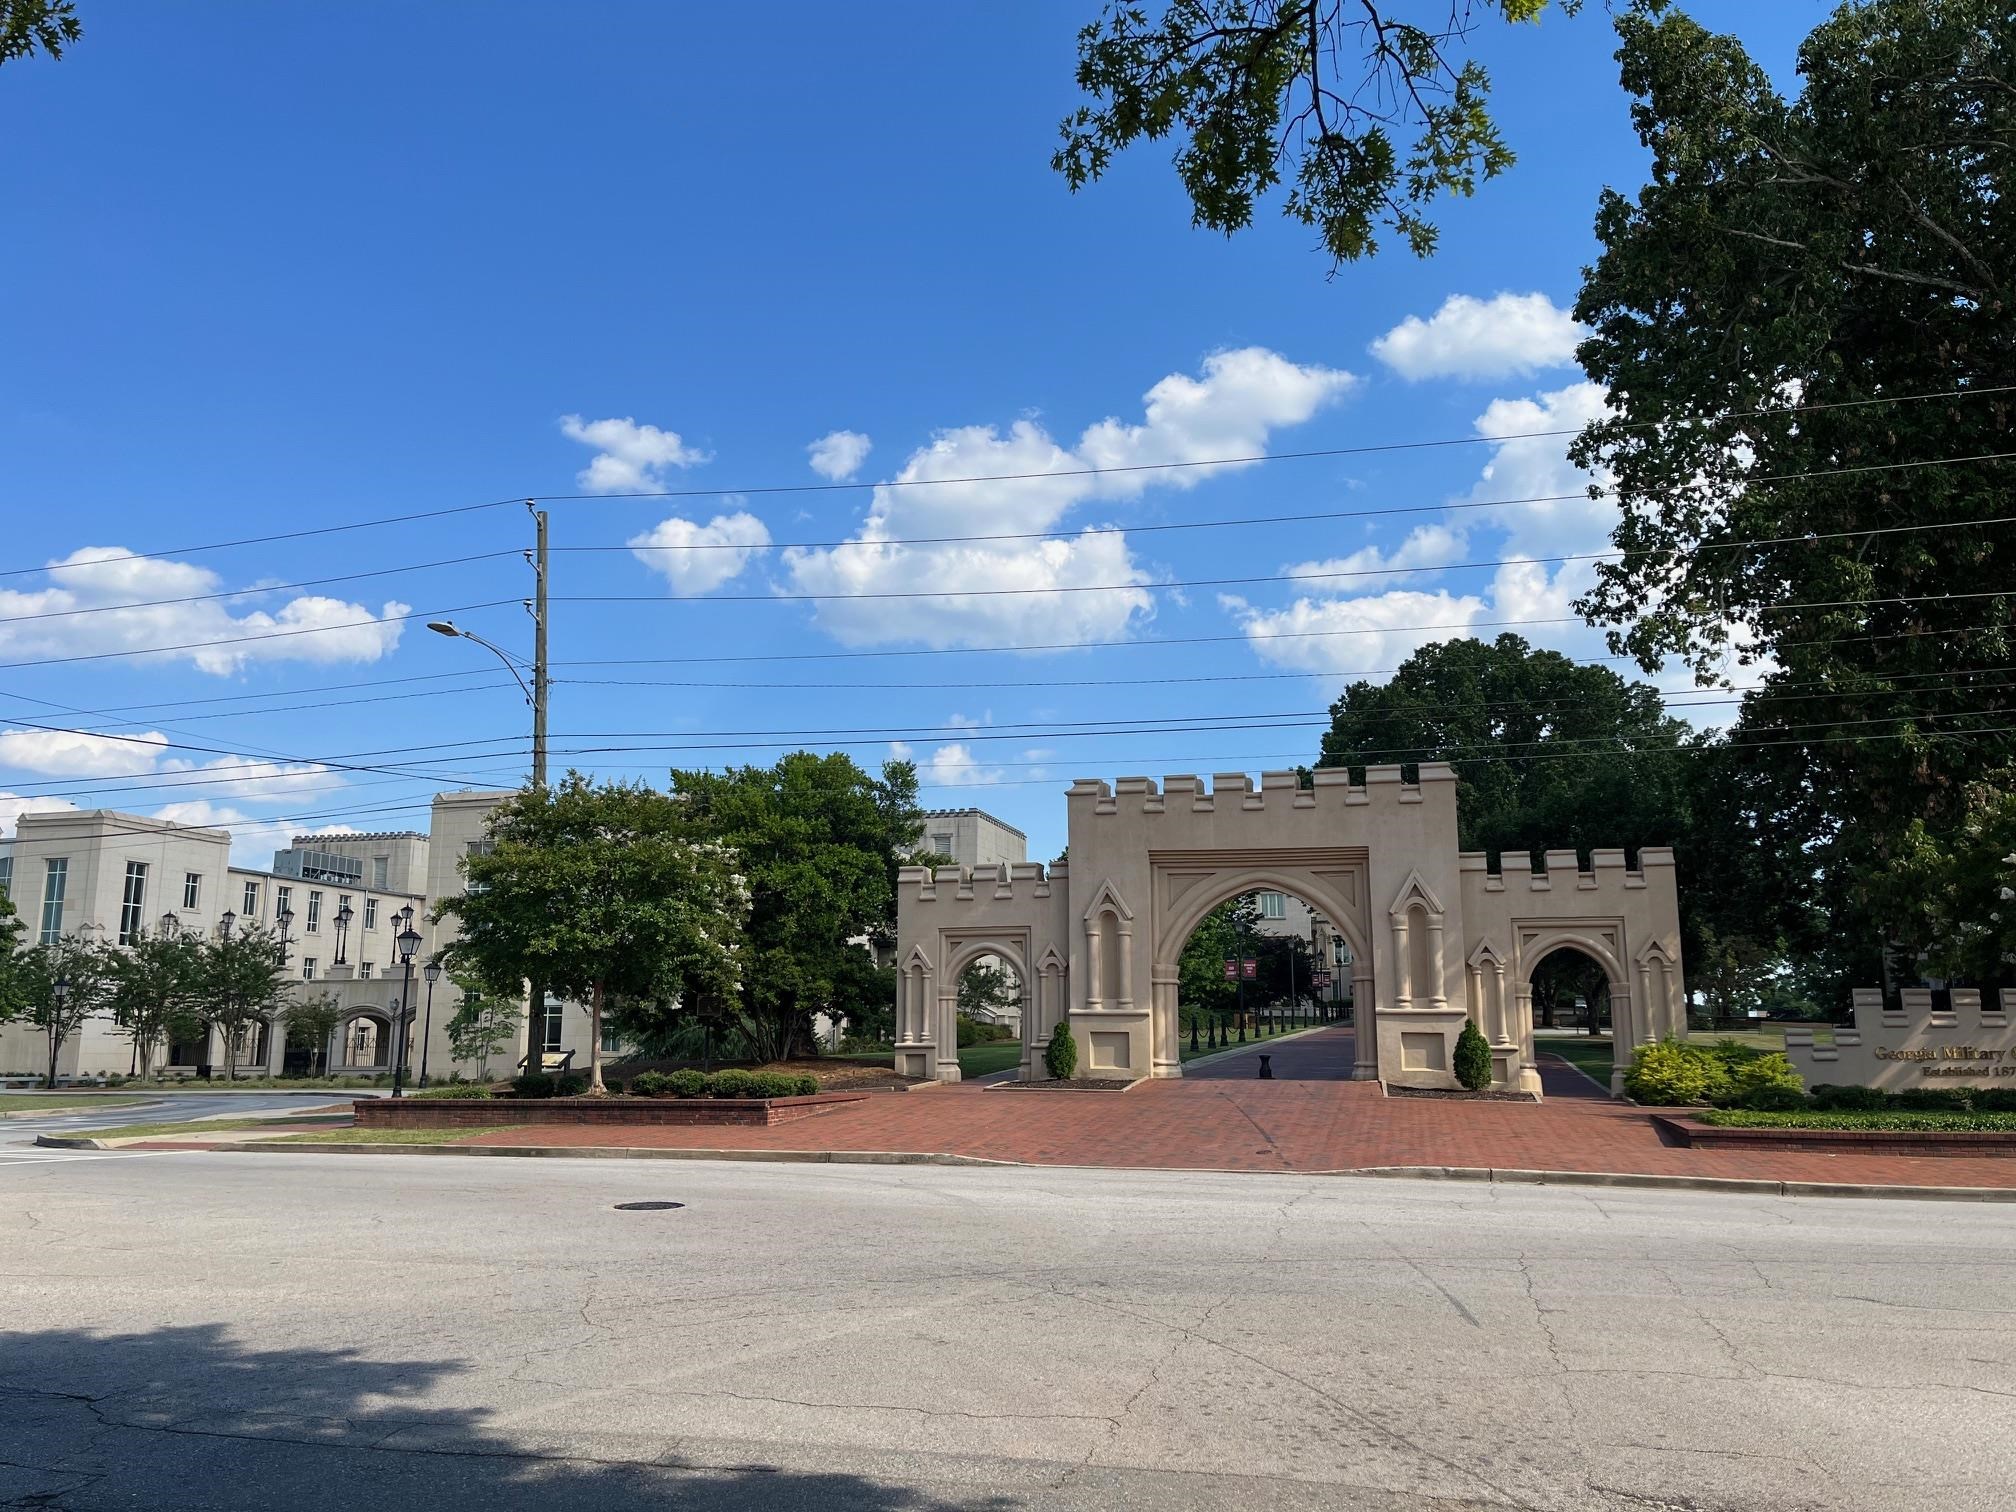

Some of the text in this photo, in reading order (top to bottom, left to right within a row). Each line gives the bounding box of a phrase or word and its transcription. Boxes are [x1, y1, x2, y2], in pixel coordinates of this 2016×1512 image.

[1875, 1046, 1937, 1063] Georgia
[1942, 1046, 2006, 1062] Military
[1922, 1066, 1990, 1077] Established
